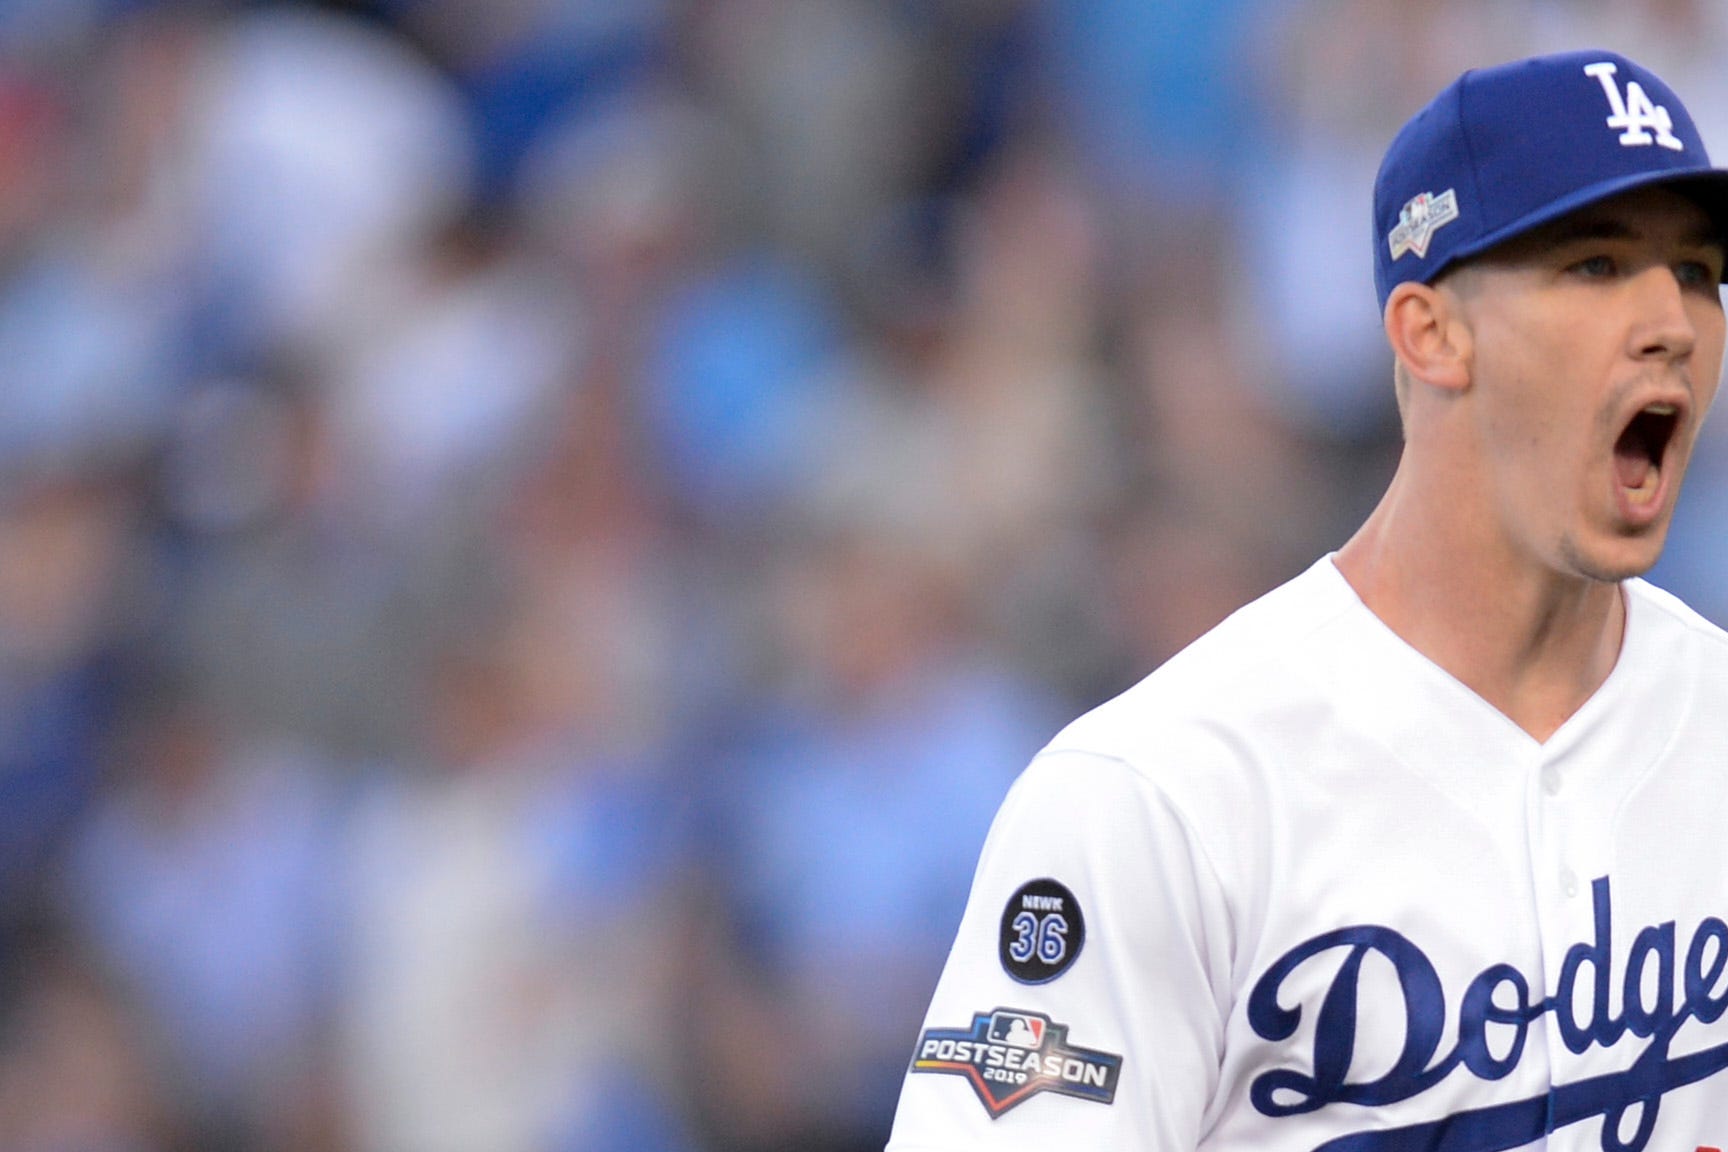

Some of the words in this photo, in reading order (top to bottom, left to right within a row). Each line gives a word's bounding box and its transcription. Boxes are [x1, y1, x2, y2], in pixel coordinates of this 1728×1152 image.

[1584, 62, 1683, 150] LA
[1022, 895, 1063, 911] NEWK
[1010, 911, 1068, 964] 36
[920, 1039, 1107, 1086] POSTSEASON
[983, 1067, 1028, 1084] 2019
